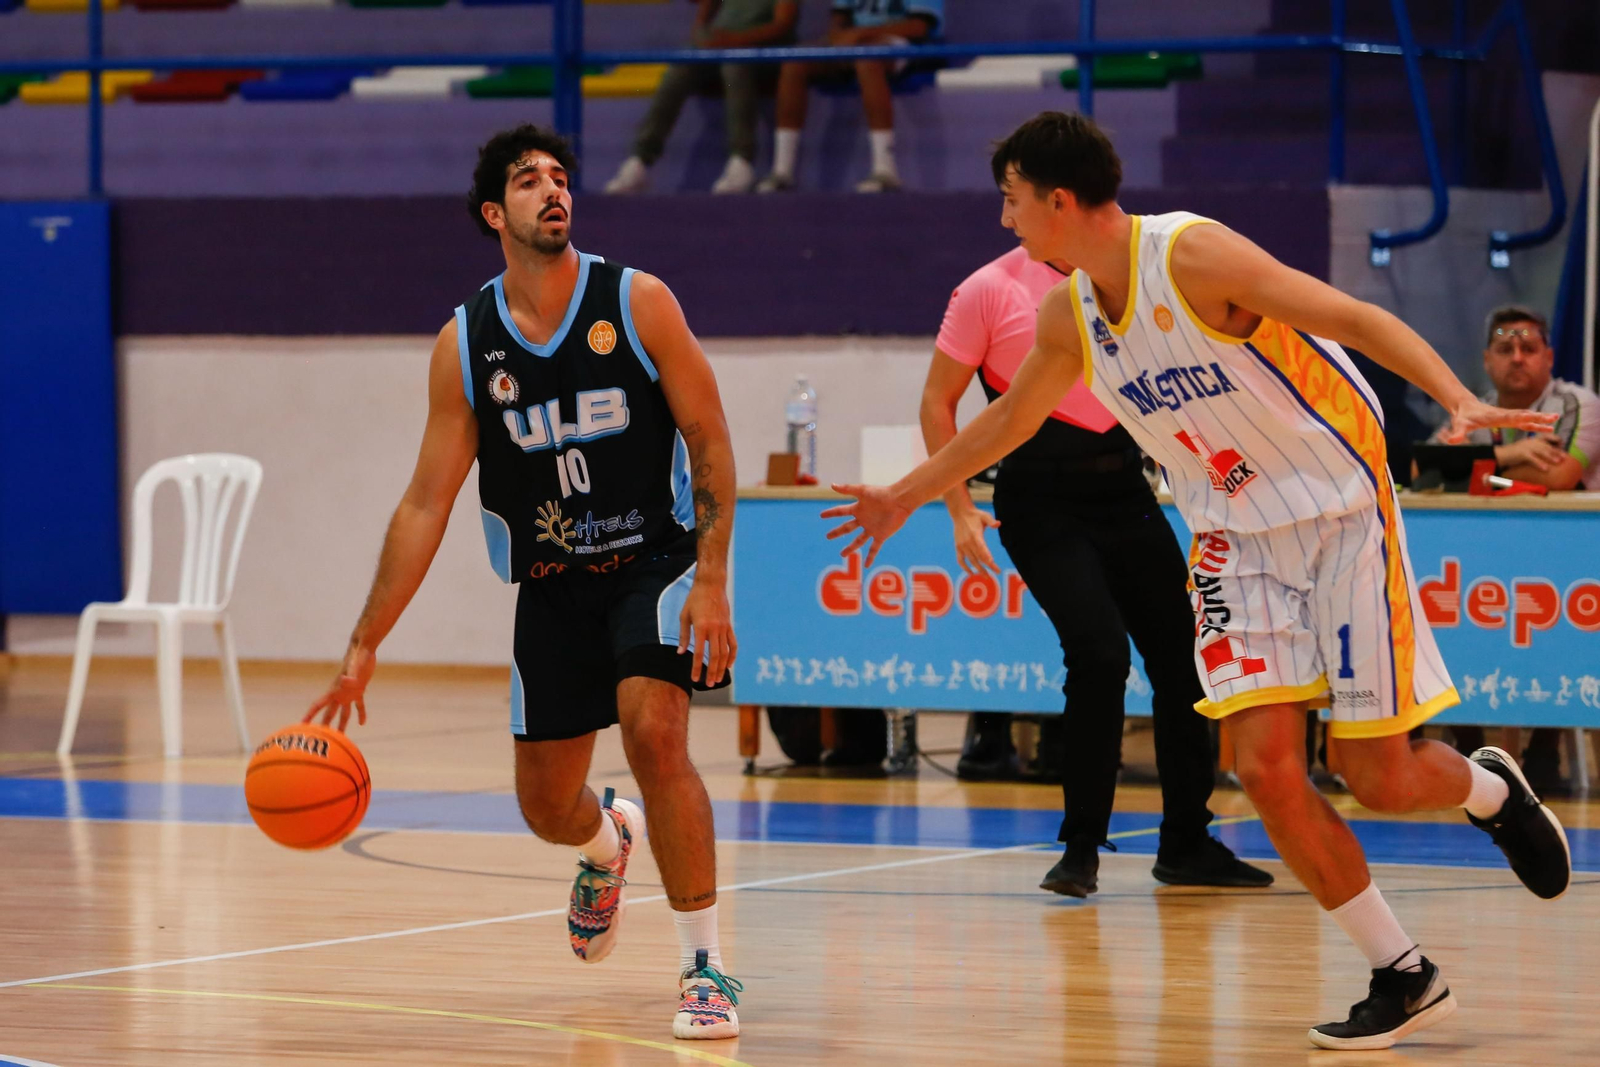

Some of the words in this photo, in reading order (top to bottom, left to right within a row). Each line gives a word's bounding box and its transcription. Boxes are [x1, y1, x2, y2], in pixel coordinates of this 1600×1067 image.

[503, 387, 630, 453] ULB
[555, 448, 591, 499] 10
[817, 550, 1029, 635] depor
[1337, 623, 1354, 679] 1
